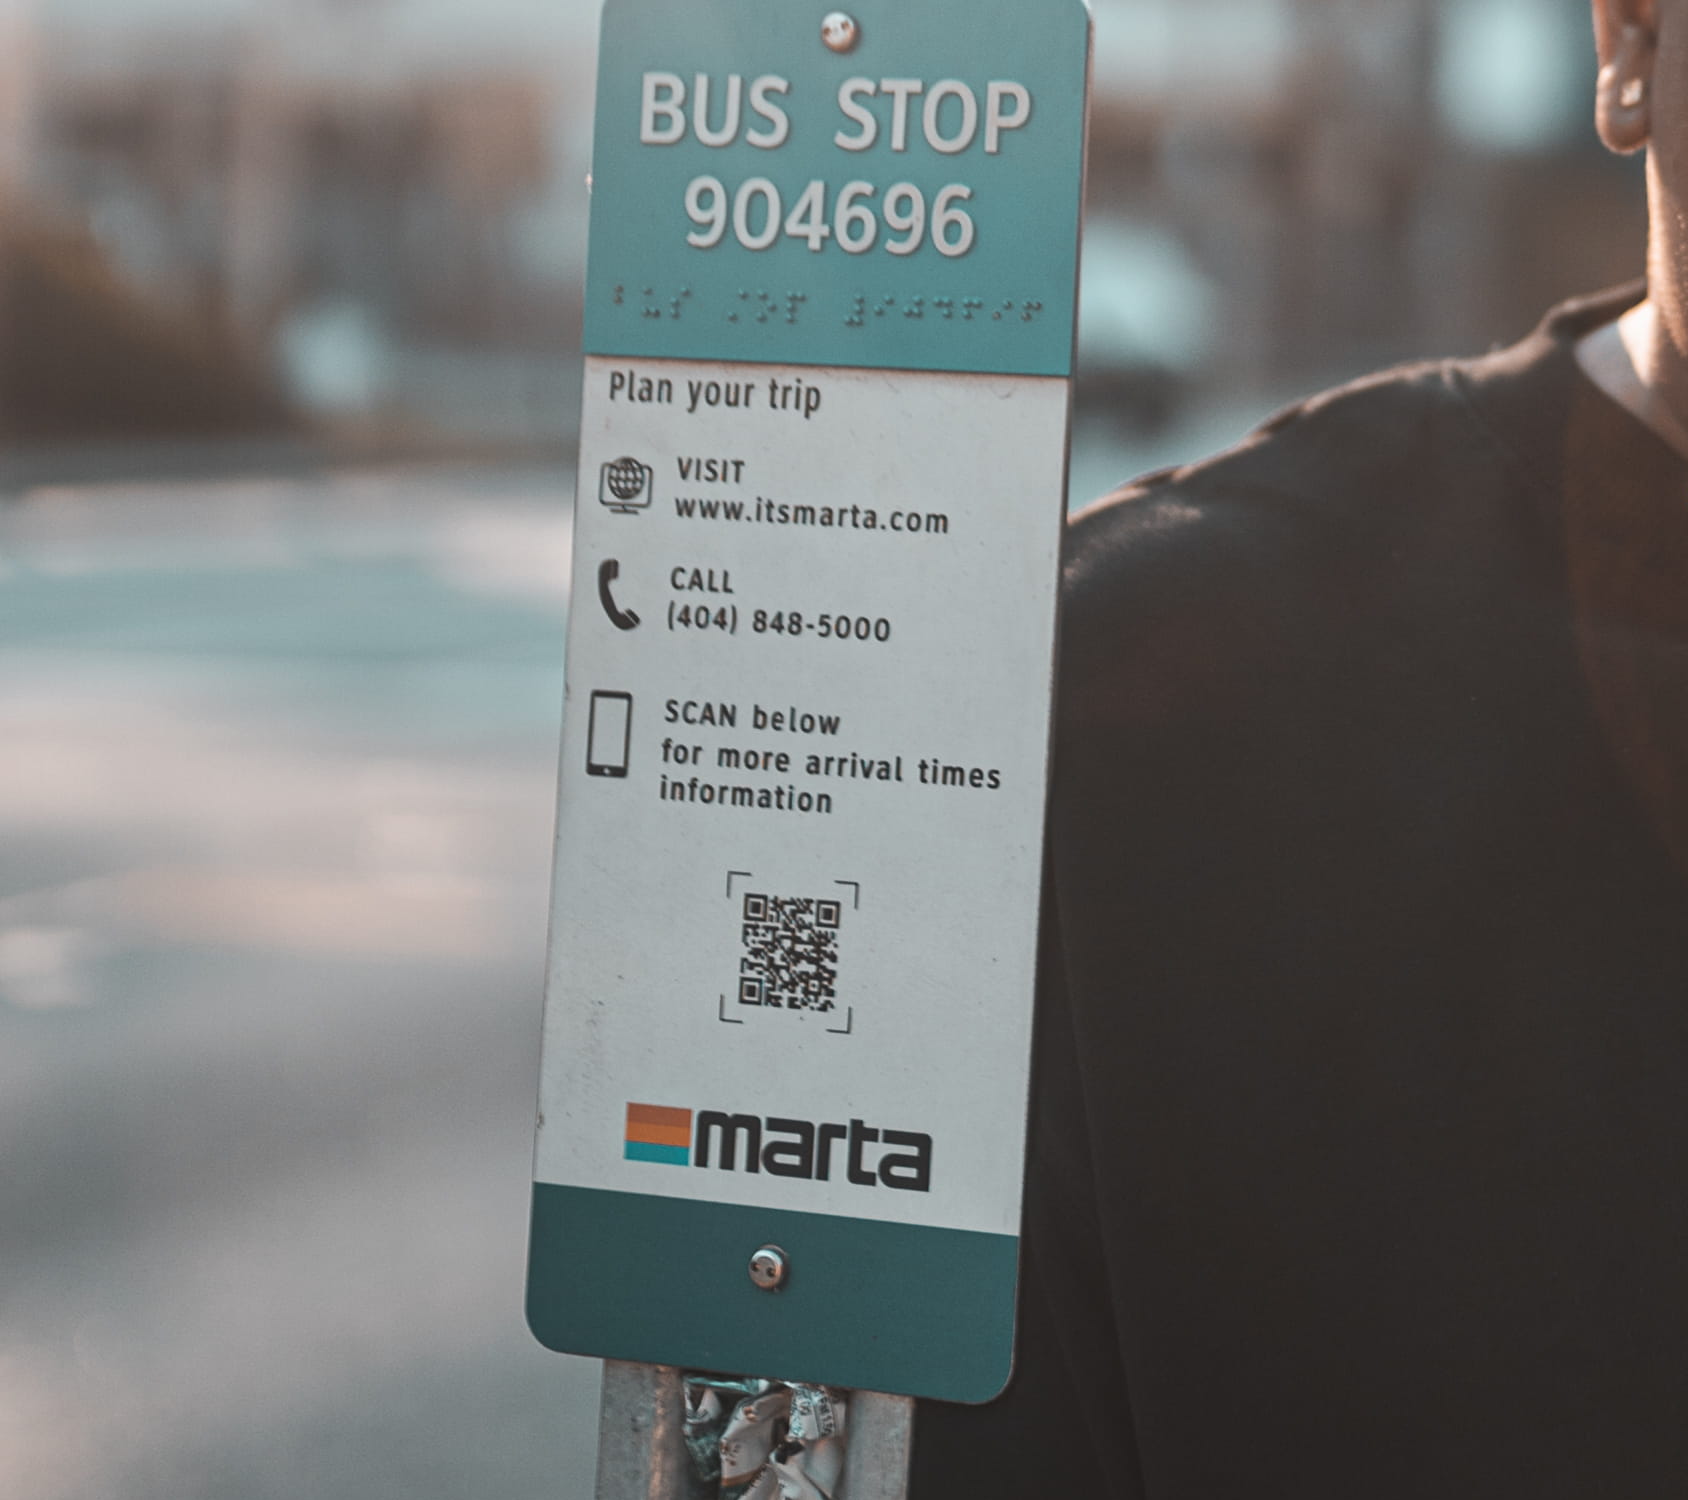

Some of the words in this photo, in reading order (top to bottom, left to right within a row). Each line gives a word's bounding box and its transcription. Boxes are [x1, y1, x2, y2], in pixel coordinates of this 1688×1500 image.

[639, 71, 792, 149] BUS
[833, 76, 1033, 155] STOP
[683, 175, 977, 258] 904696
[609, 370, 673, 404] Plan
[686, 378, 756, 414] your
[768, 377, 822, 420] trip
[677, 456, 746, 484] VISIT
[674, 496, 950, 535] www.itsmarta.com
[670, 565, 735, 595] CALL
[667, 599, 738, 635] (404)
[751, 609, 892, 643] 848-5000
[664, 698, 738, 729] SCAN
[752, 703, 841, 736] below
[660, 737, 703, 766] for
[717, 746, 791, 773] more
[805, 752, 903, 783] arrival
[918, 758, 1002, 790] times
[659, 774, 834, 815] information
[694, 1108, 934, 1193] marta
